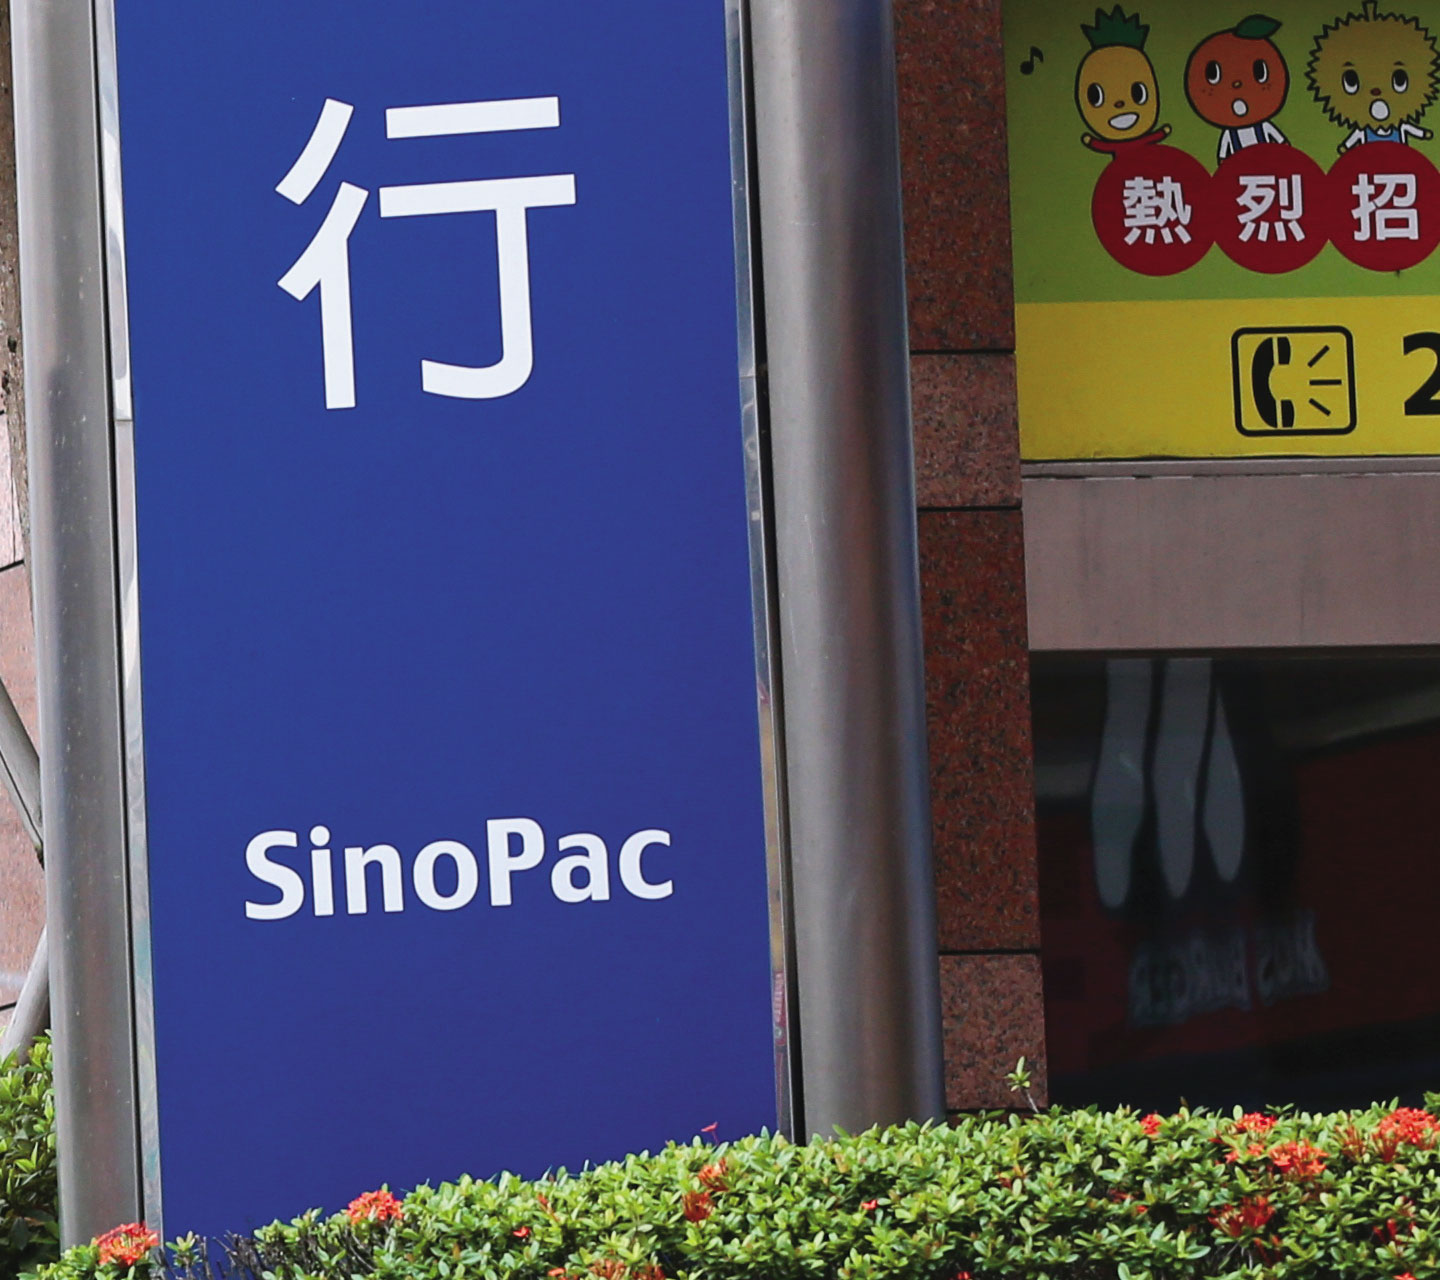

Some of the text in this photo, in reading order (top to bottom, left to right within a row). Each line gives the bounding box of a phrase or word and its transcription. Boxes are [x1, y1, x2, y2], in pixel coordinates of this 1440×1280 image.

[1122, 173, 1420, 245] 熱烈招
[245, 817, 673, 921] SinoPac
